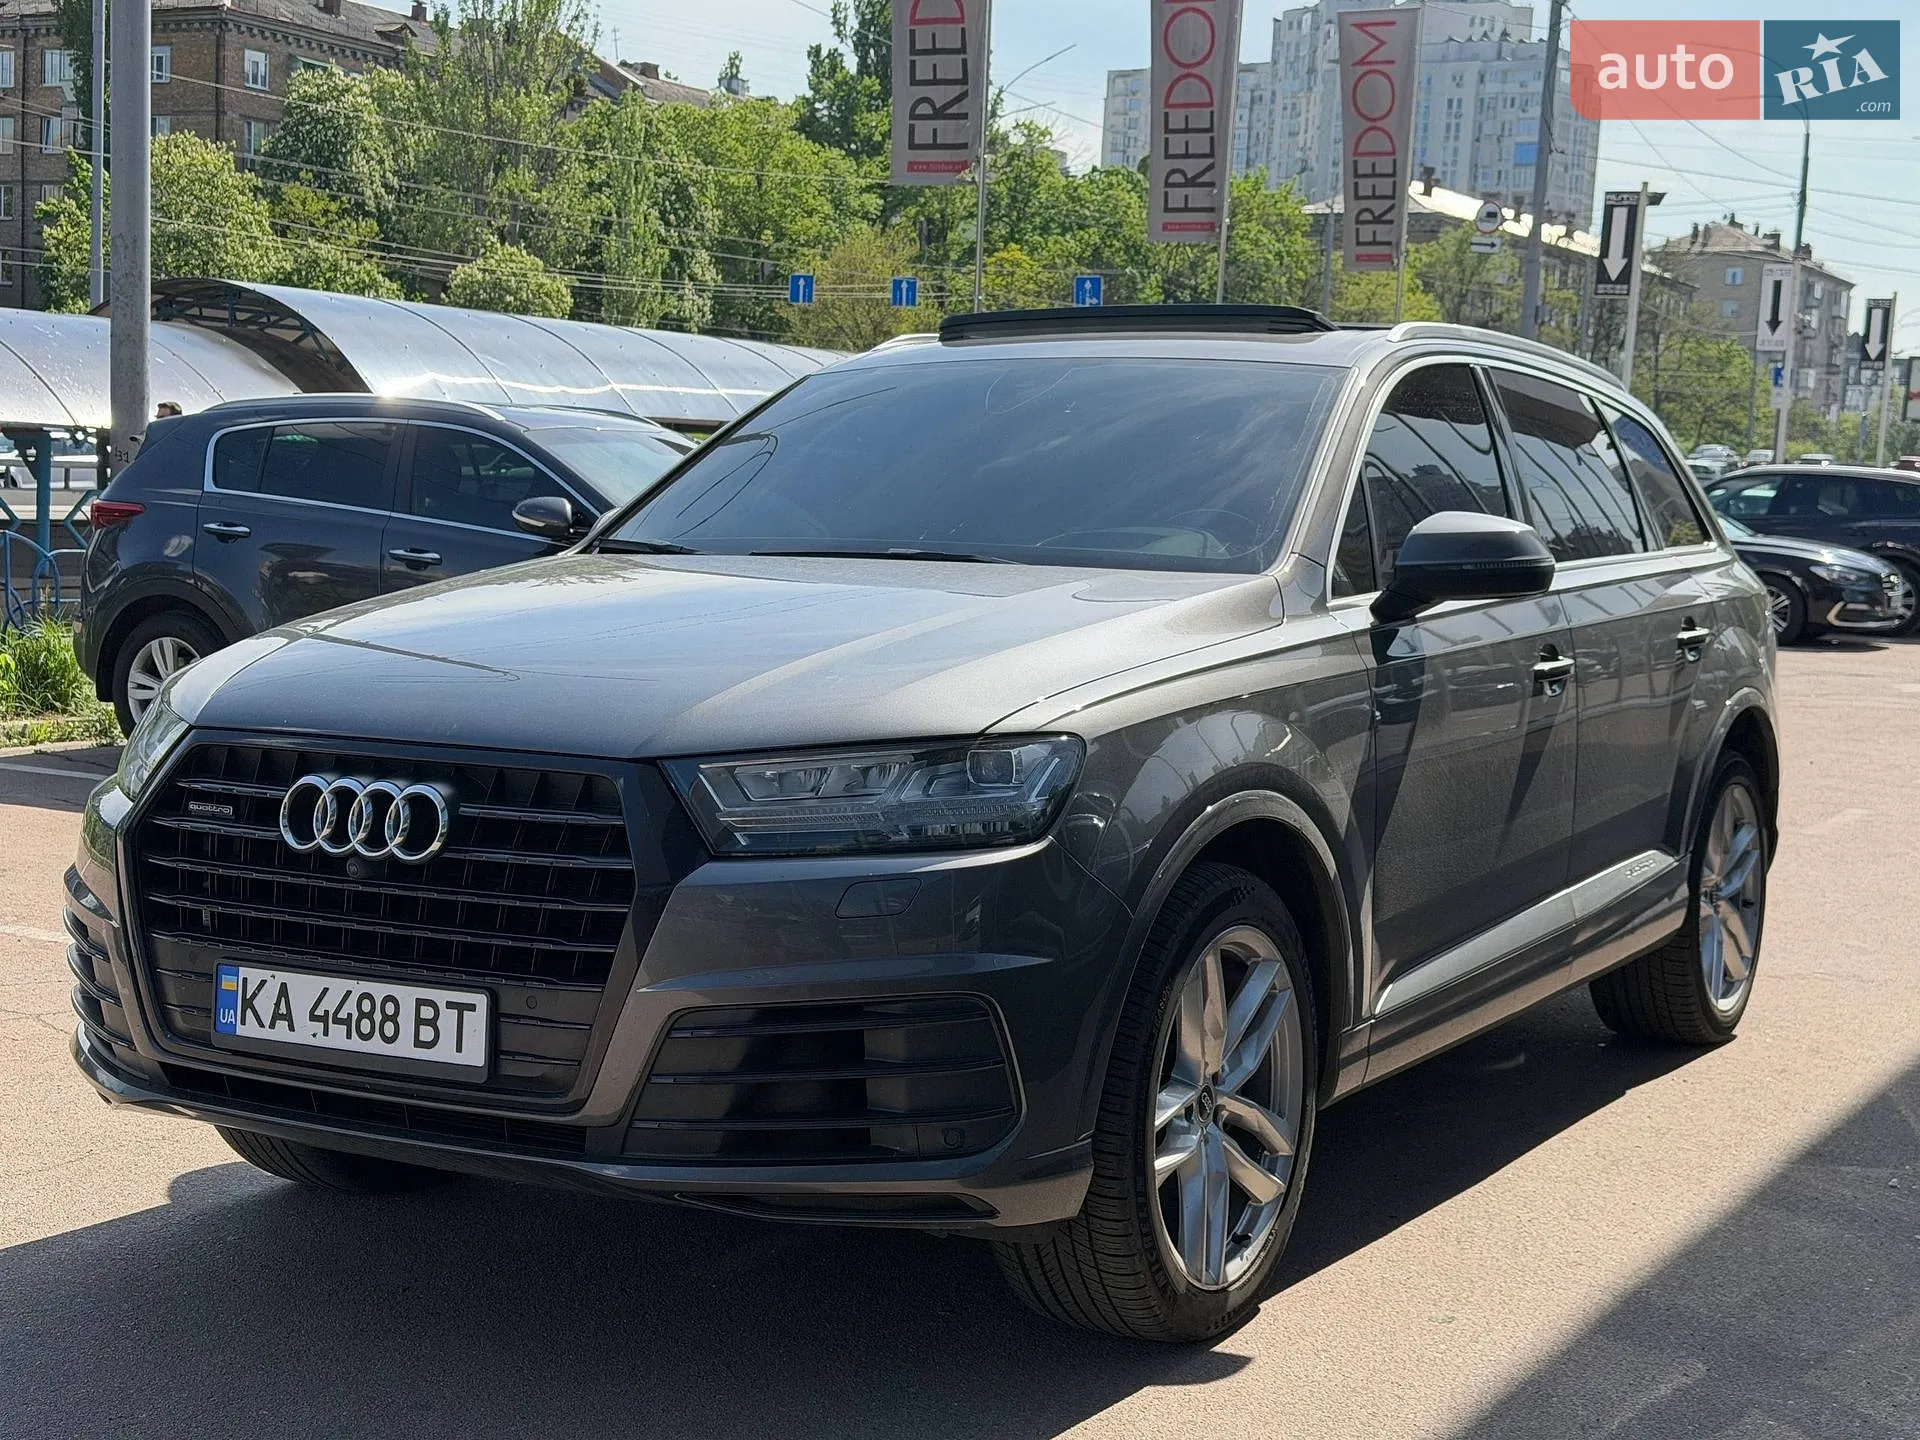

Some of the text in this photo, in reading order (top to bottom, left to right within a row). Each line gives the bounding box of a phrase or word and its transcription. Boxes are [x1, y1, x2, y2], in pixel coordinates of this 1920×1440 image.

[1163, 0, 1217, 213] FREEDO
[1350, 20, 1397, 246] FREEDOM
[189, 803, 231, 814] quattro
[219, 1007, 236, 1025] UA
[240, 976, 477, 1054] KA 4488 BT
